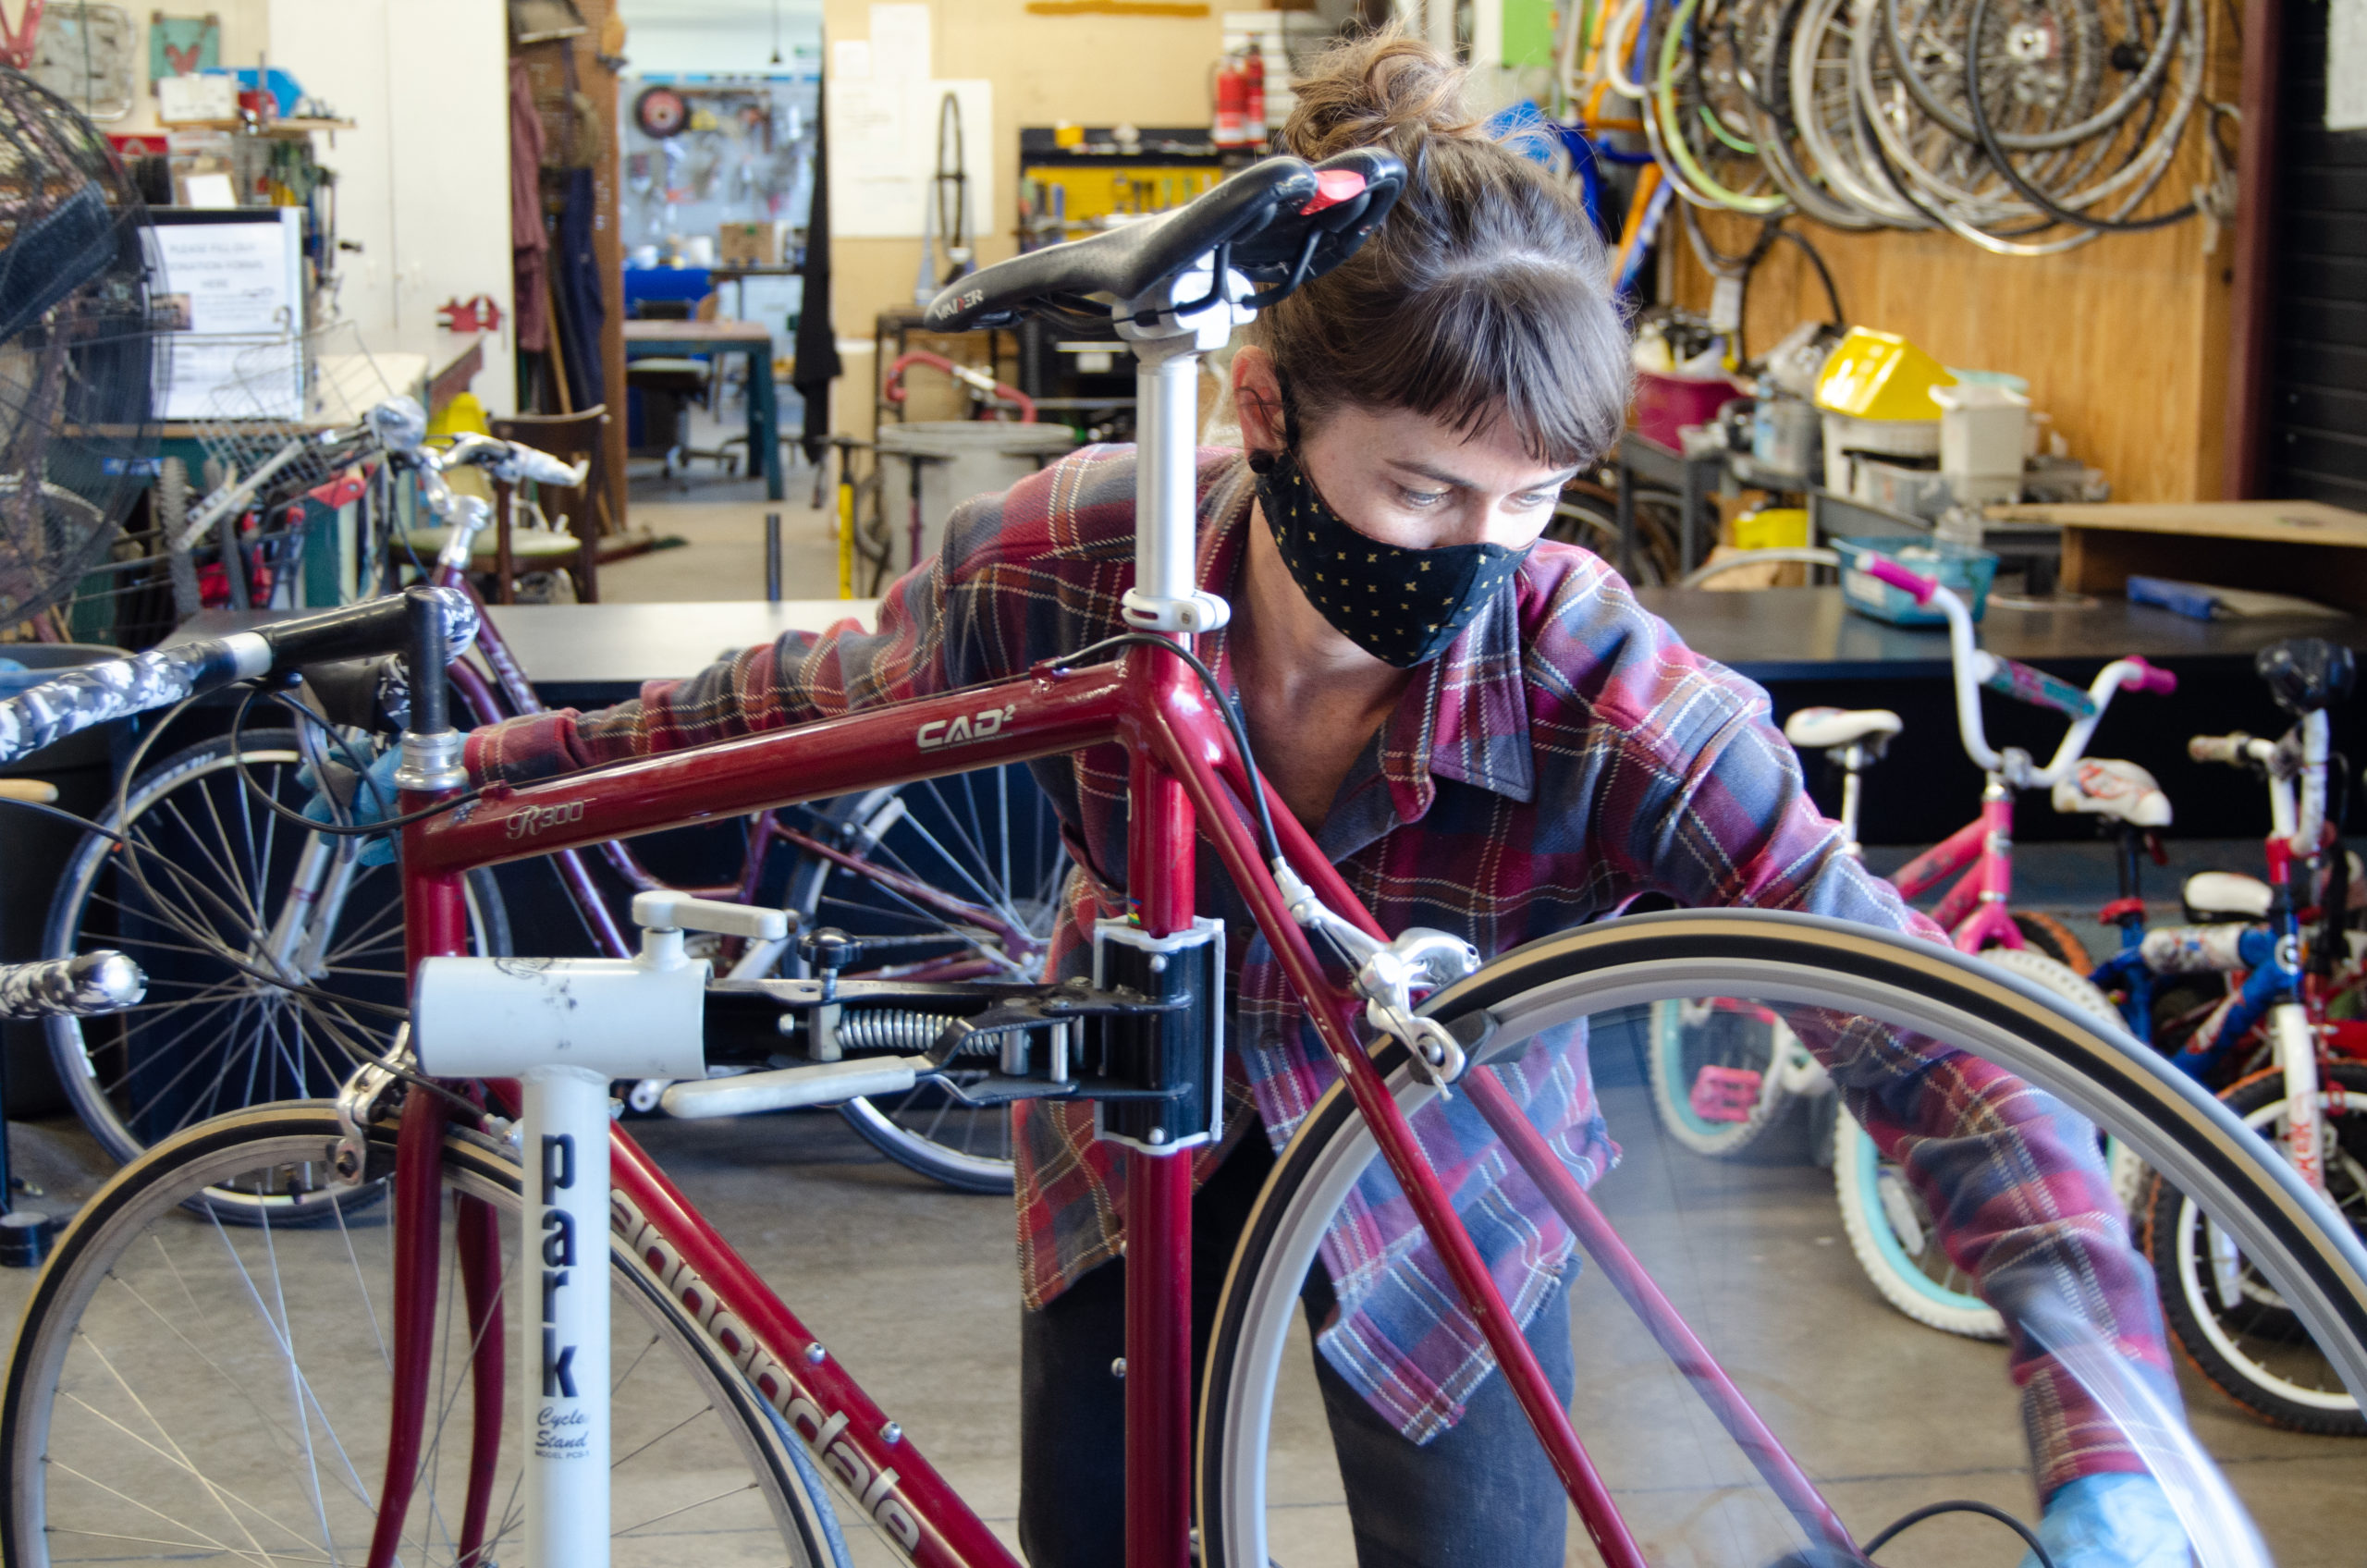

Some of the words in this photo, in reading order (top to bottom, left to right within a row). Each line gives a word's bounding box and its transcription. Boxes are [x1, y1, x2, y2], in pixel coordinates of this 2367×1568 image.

[506, 800, 585, 840] R300
[541, 1133, 580, 1399] park
[610, 1188, 921, 1555] annondale
[537, 1406, 585, 1429] Cycle
[535, 1430, 589, 1449] Stand
